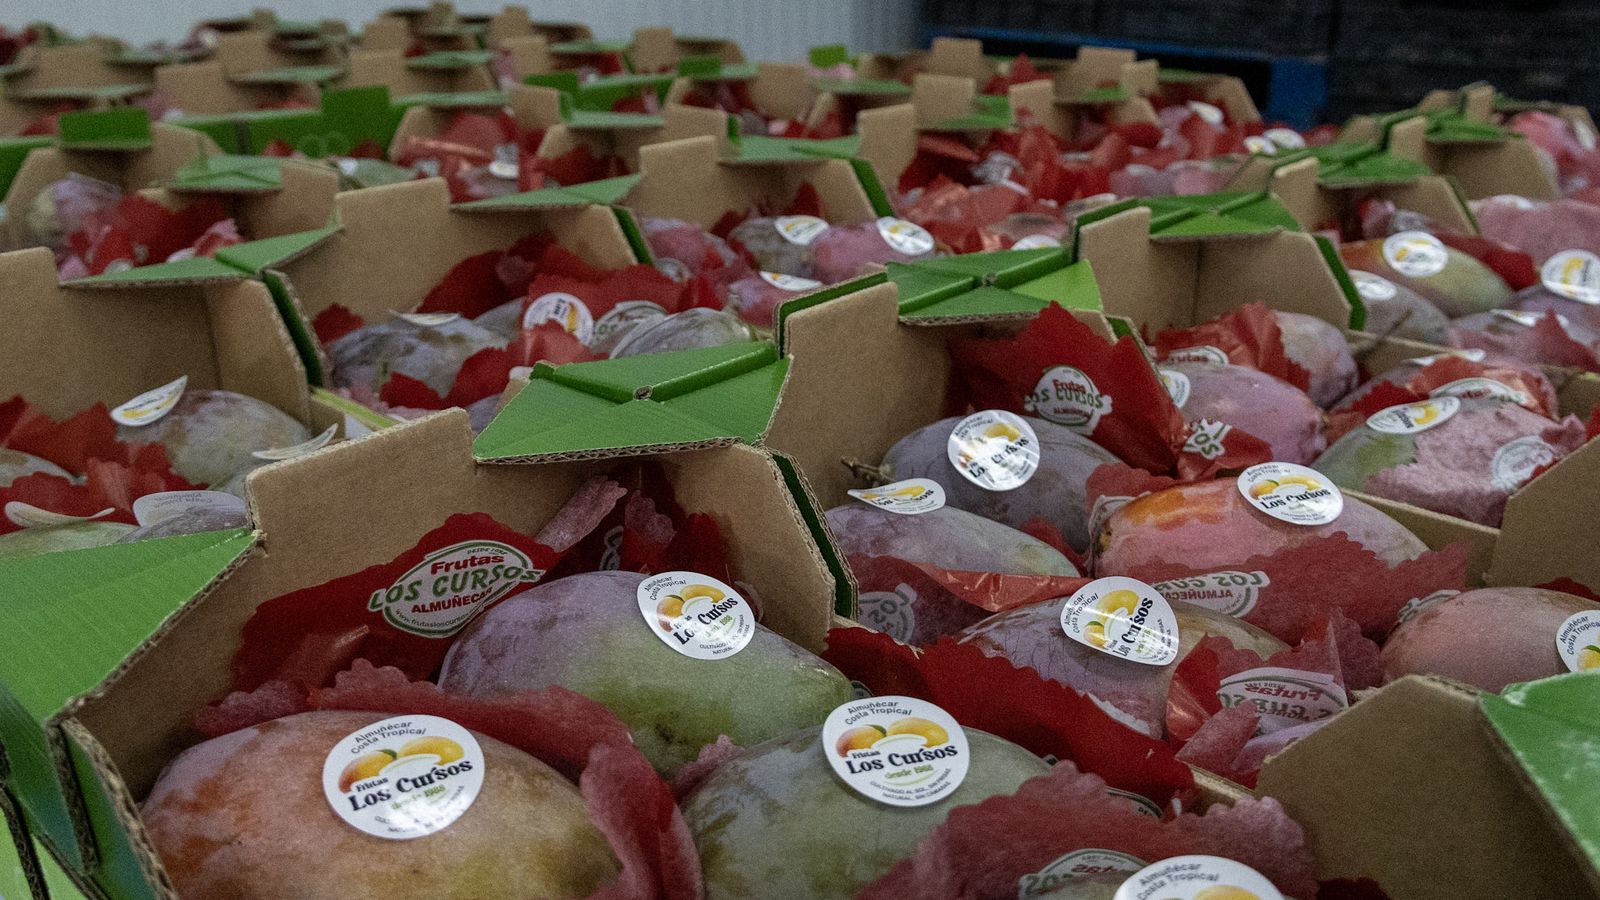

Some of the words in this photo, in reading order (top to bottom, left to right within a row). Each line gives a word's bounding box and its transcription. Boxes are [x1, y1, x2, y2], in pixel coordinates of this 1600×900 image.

[1056, 389, 1105, 409] CURSOS
[1260, 499, 1287, 510] Los
[1286, 488, 1332, 502] Cursos
[431, 554, 505, 575] Frutas
[368, 579, 423, 611] LOS
[432, 564, 542, 597] CURSOS
[697, 597, 738, 625] Cursos
[1121, 597, 1154, 644] Cursos
[1560, 616, 1589, 644] Almuñécar
[1567, 635, 1577, 656] Costa
[844, 711, 869, 726] Costa
[870, 706, 913, 717] Tropical
[847, 701, 899, 715] Almuñécar
[351, 736, 379, 755] Costa
[380, 727, 427, 740] Tropical
[355, 721, 413, 744] Almuñécar
[845, 759, 885, 775] Los
[887, 744, 959, 767] Cursos
[851, 750, 881, 760] Frutas
[348, 788, 393, 811] Los
[395, 760, 474, 793] Cursos
[356, 776, 390, 793] Frutas
[1139, 862, 1202, 886] Almuñécar
[1167, 871, 1219, 882] Tropical
